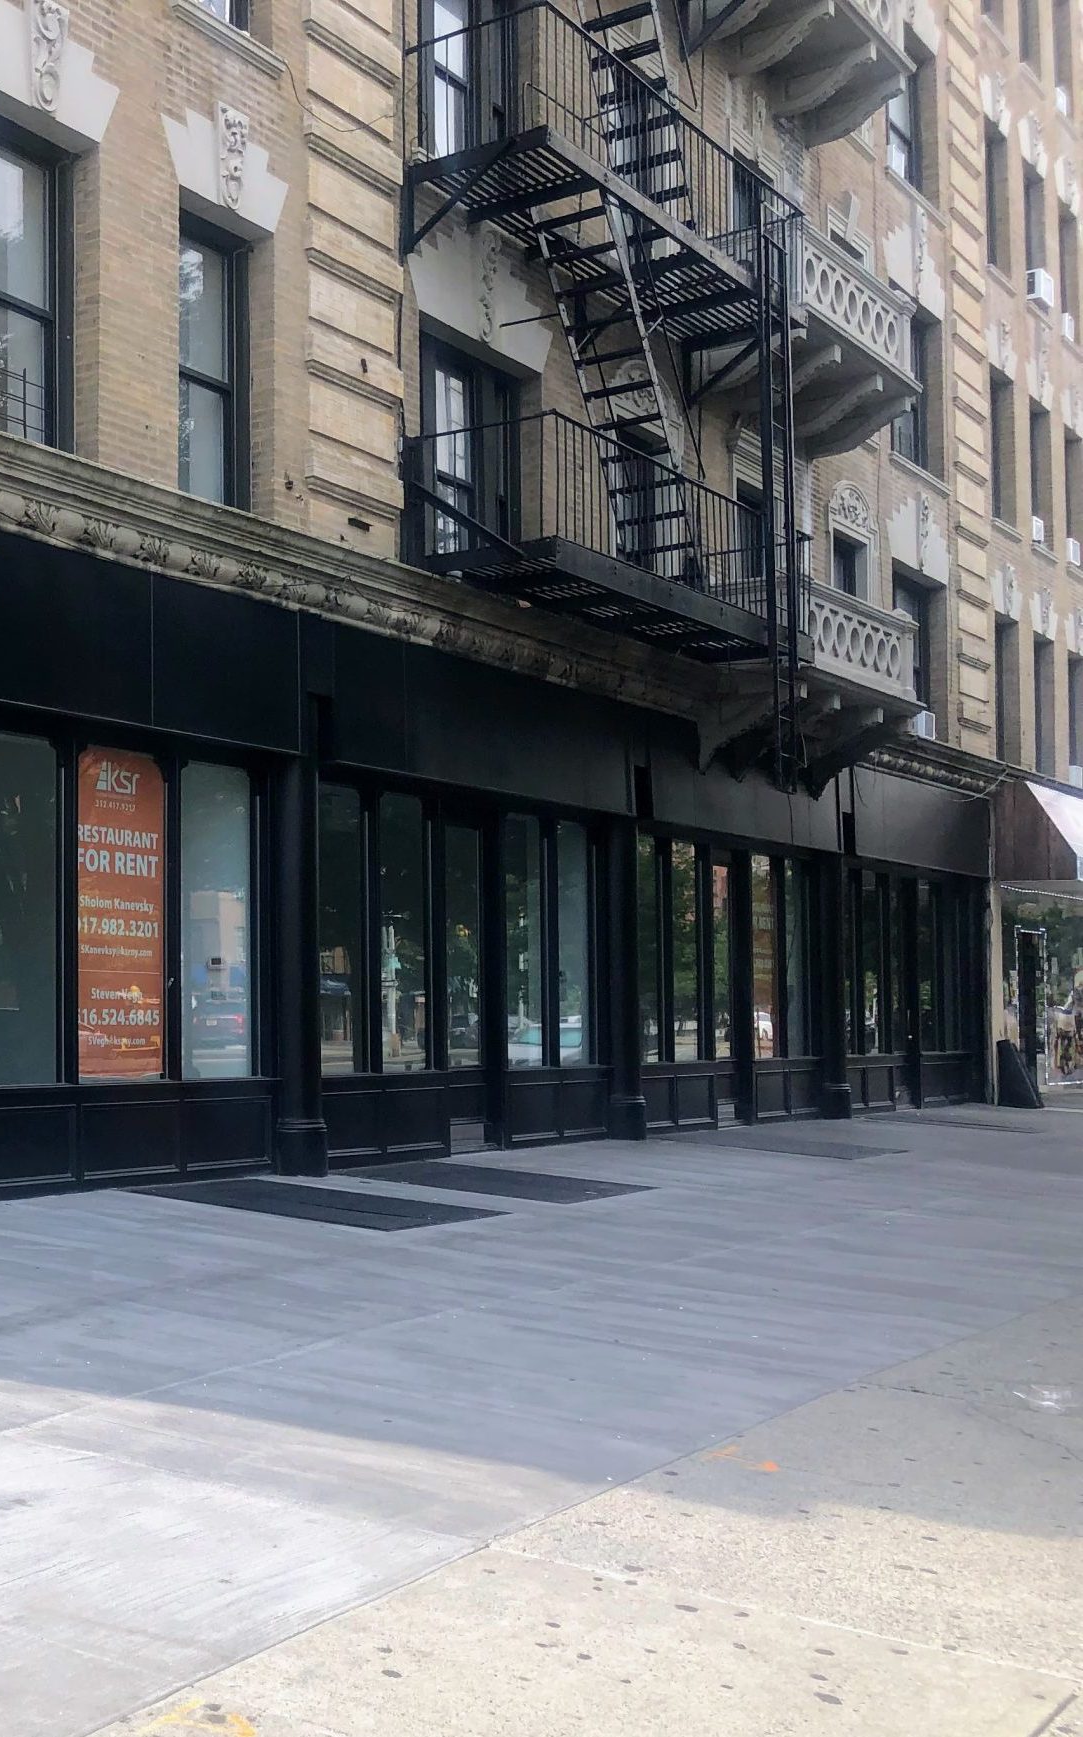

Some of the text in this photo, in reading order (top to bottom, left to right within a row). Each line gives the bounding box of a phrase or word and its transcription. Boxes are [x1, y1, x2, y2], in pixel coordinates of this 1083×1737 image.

[77, 824, 159, 850] RESTAURANT
[77, 847, 159, 878] FOR RENT
[79, 895, 155, 915] Sholom Kanevsky
[91, 987, 122, 1001] Steven
